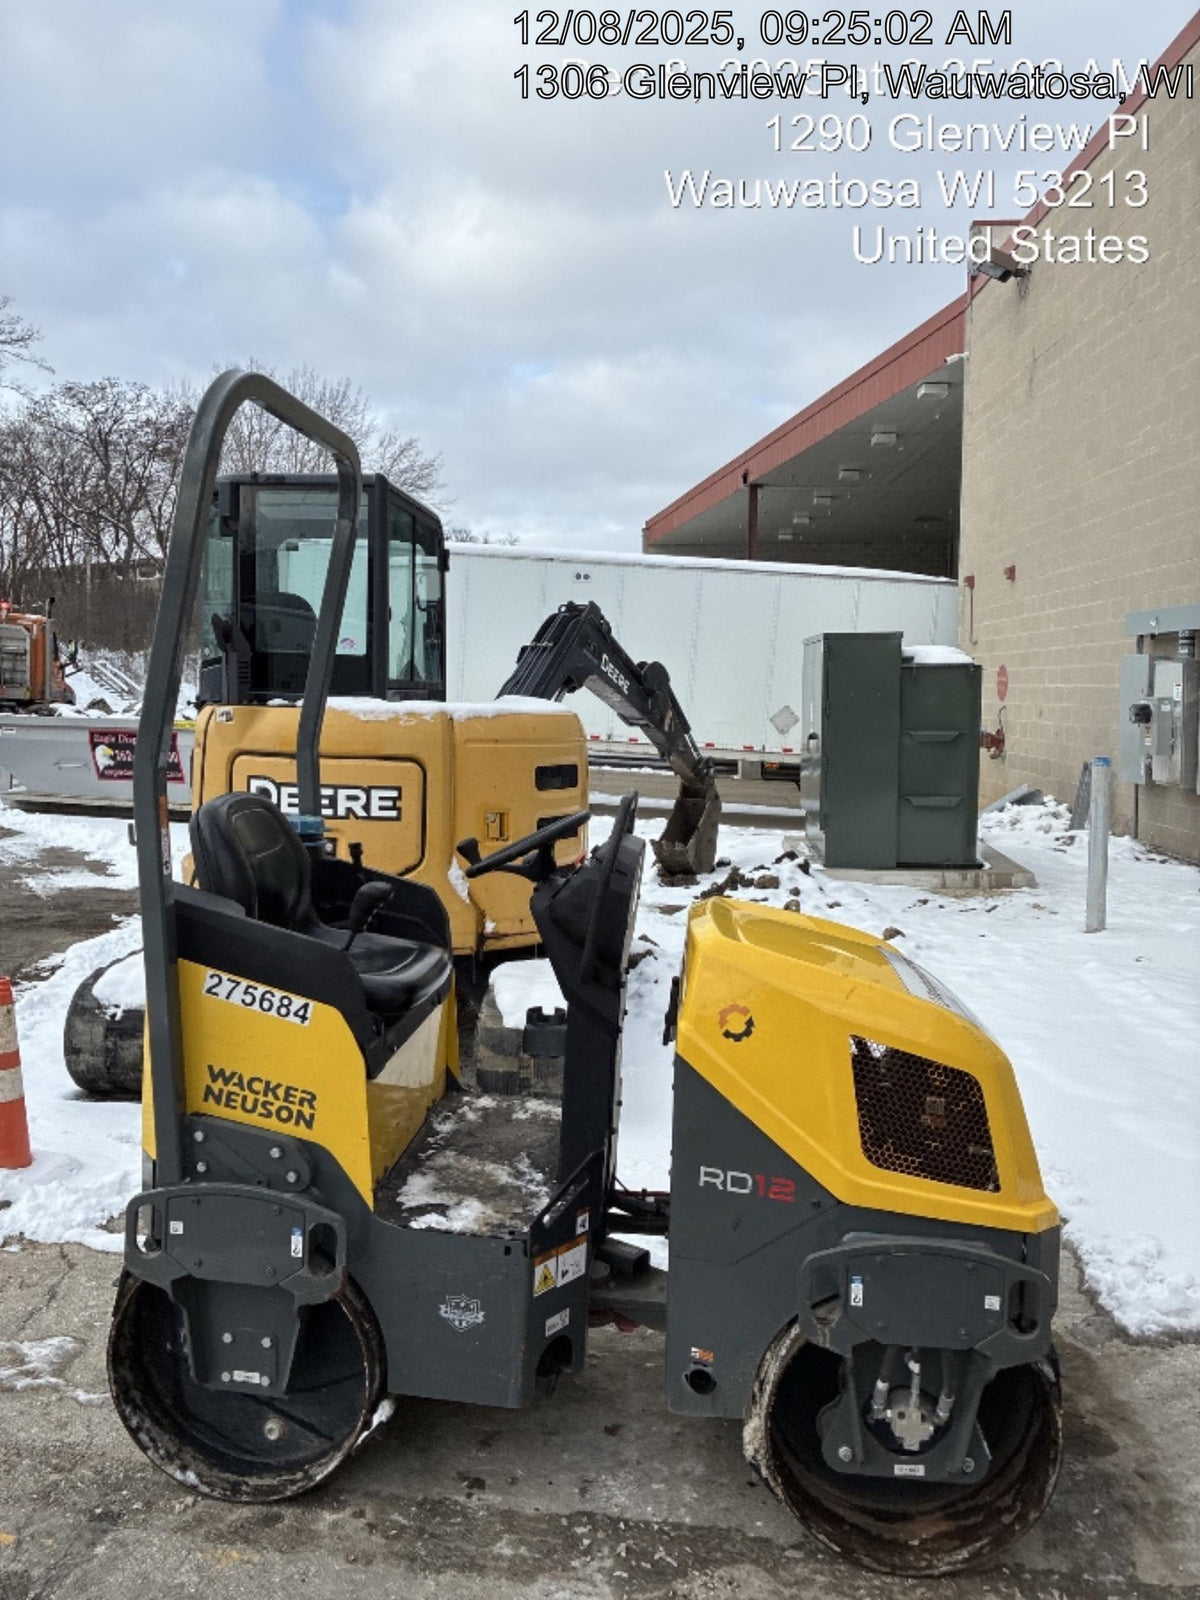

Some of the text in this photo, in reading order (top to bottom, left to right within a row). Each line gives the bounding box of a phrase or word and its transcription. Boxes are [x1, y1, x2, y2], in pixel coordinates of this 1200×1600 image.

[205, 973, 310, 1024] 275684
[202, 1083, 315, 1130] NEUSON
[207, 1064, 317, 1111] WACKER
[699, 1165, 796, 1203] RD12
